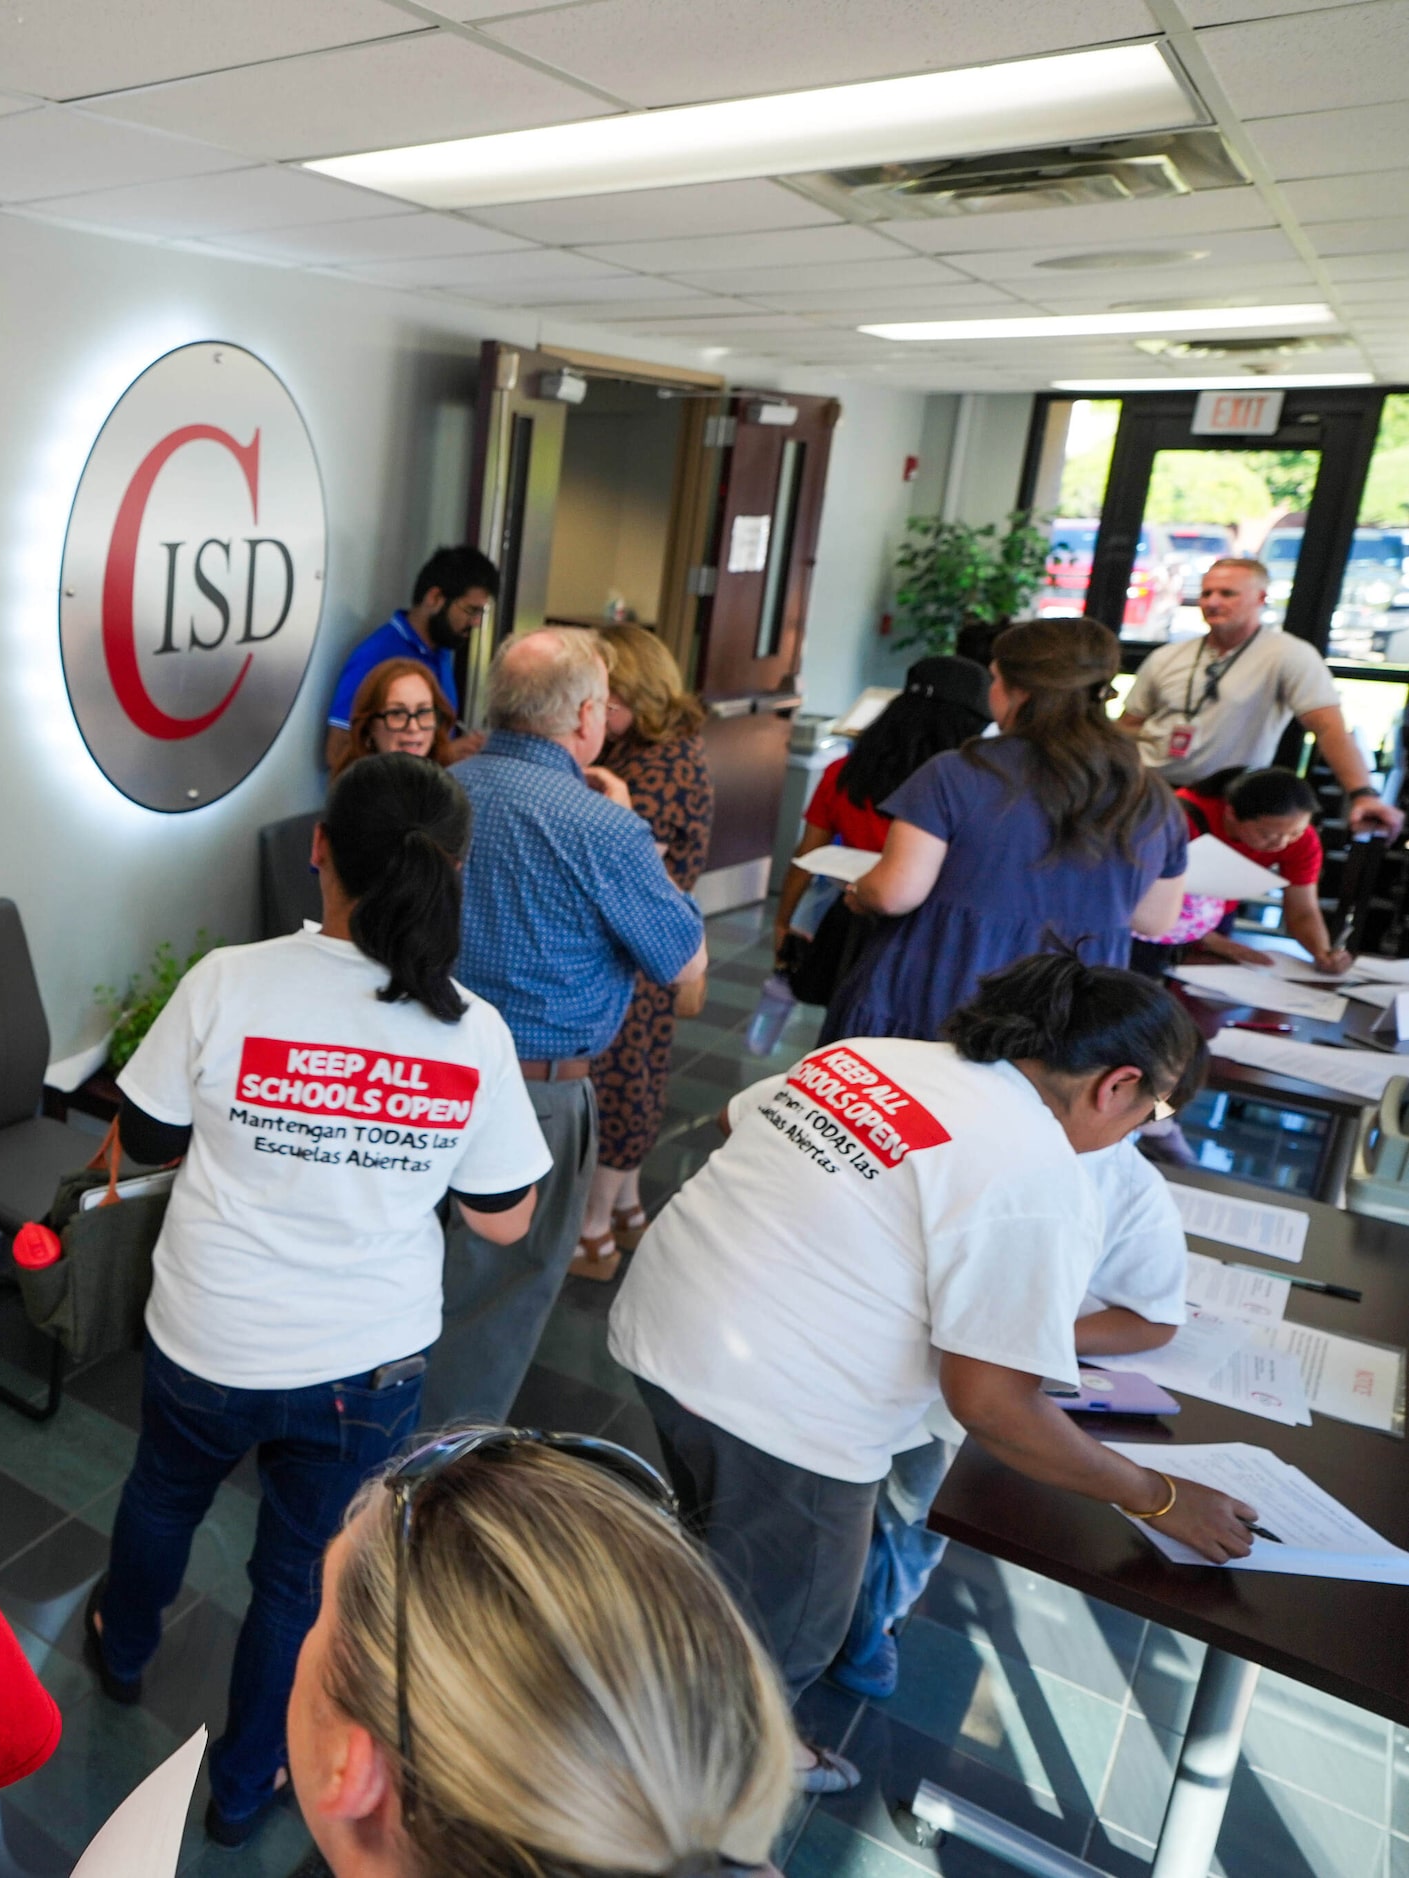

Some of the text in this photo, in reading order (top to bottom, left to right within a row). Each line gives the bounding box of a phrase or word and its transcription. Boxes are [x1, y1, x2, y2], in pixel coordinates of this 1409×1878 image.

[1210, 396, 1270, 428] EXIT
[287, 1048, 429, 1090] KEEP ALL
[822, 1051, 910, 1116] KEEP ALL
[241, 1074, 470, 1123] SCHOOLS OPEN
[794, 1062, 859, 1110] CHOOLS
[844, 1101, 912, 1161] OPEN
[229, 1107, 460, 1150] Mantengan TODAS las
[784, 1124, 840, 1173] Abiertas
[254, 1136, 432, 1173] Escuelas Abiertas
[849, 1151, 880, 1181] las
